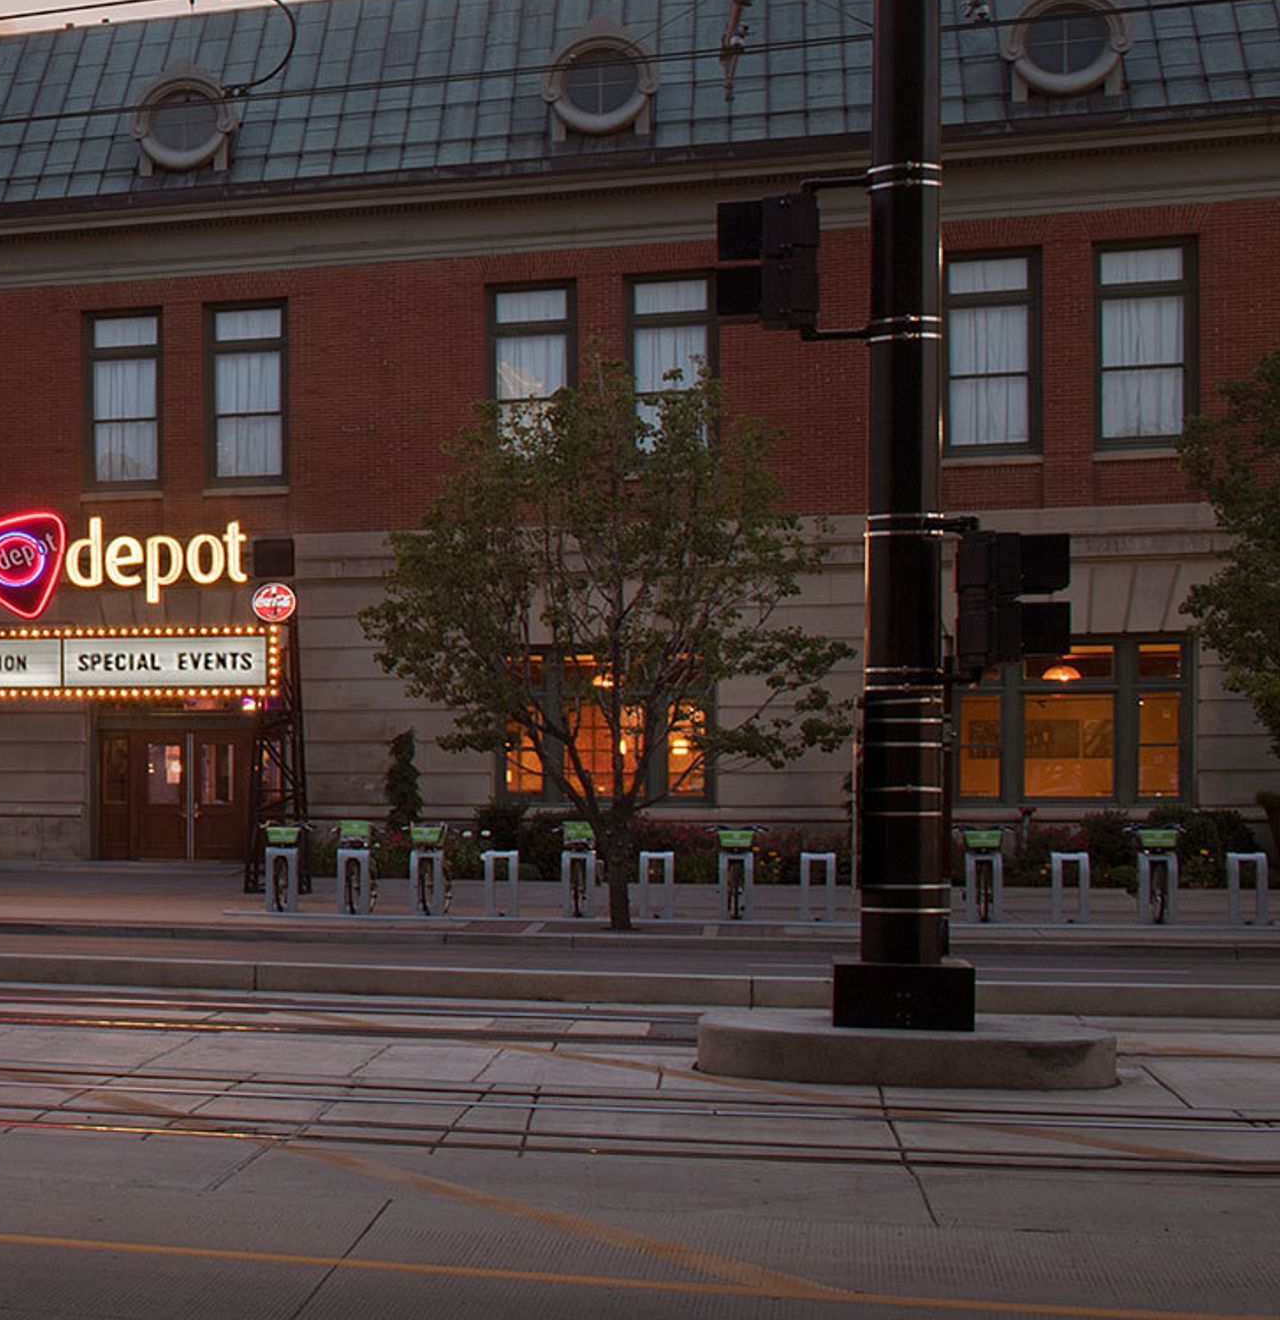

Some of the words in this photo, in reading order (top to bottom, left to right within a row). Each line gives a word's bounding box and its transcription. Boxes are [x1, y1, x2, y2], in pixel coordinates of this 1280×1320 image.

[65, 517, 248, 604] depot
[77, 651, 161, 672] SPECIAL
[177, 650, 254, 670] EVENTS
